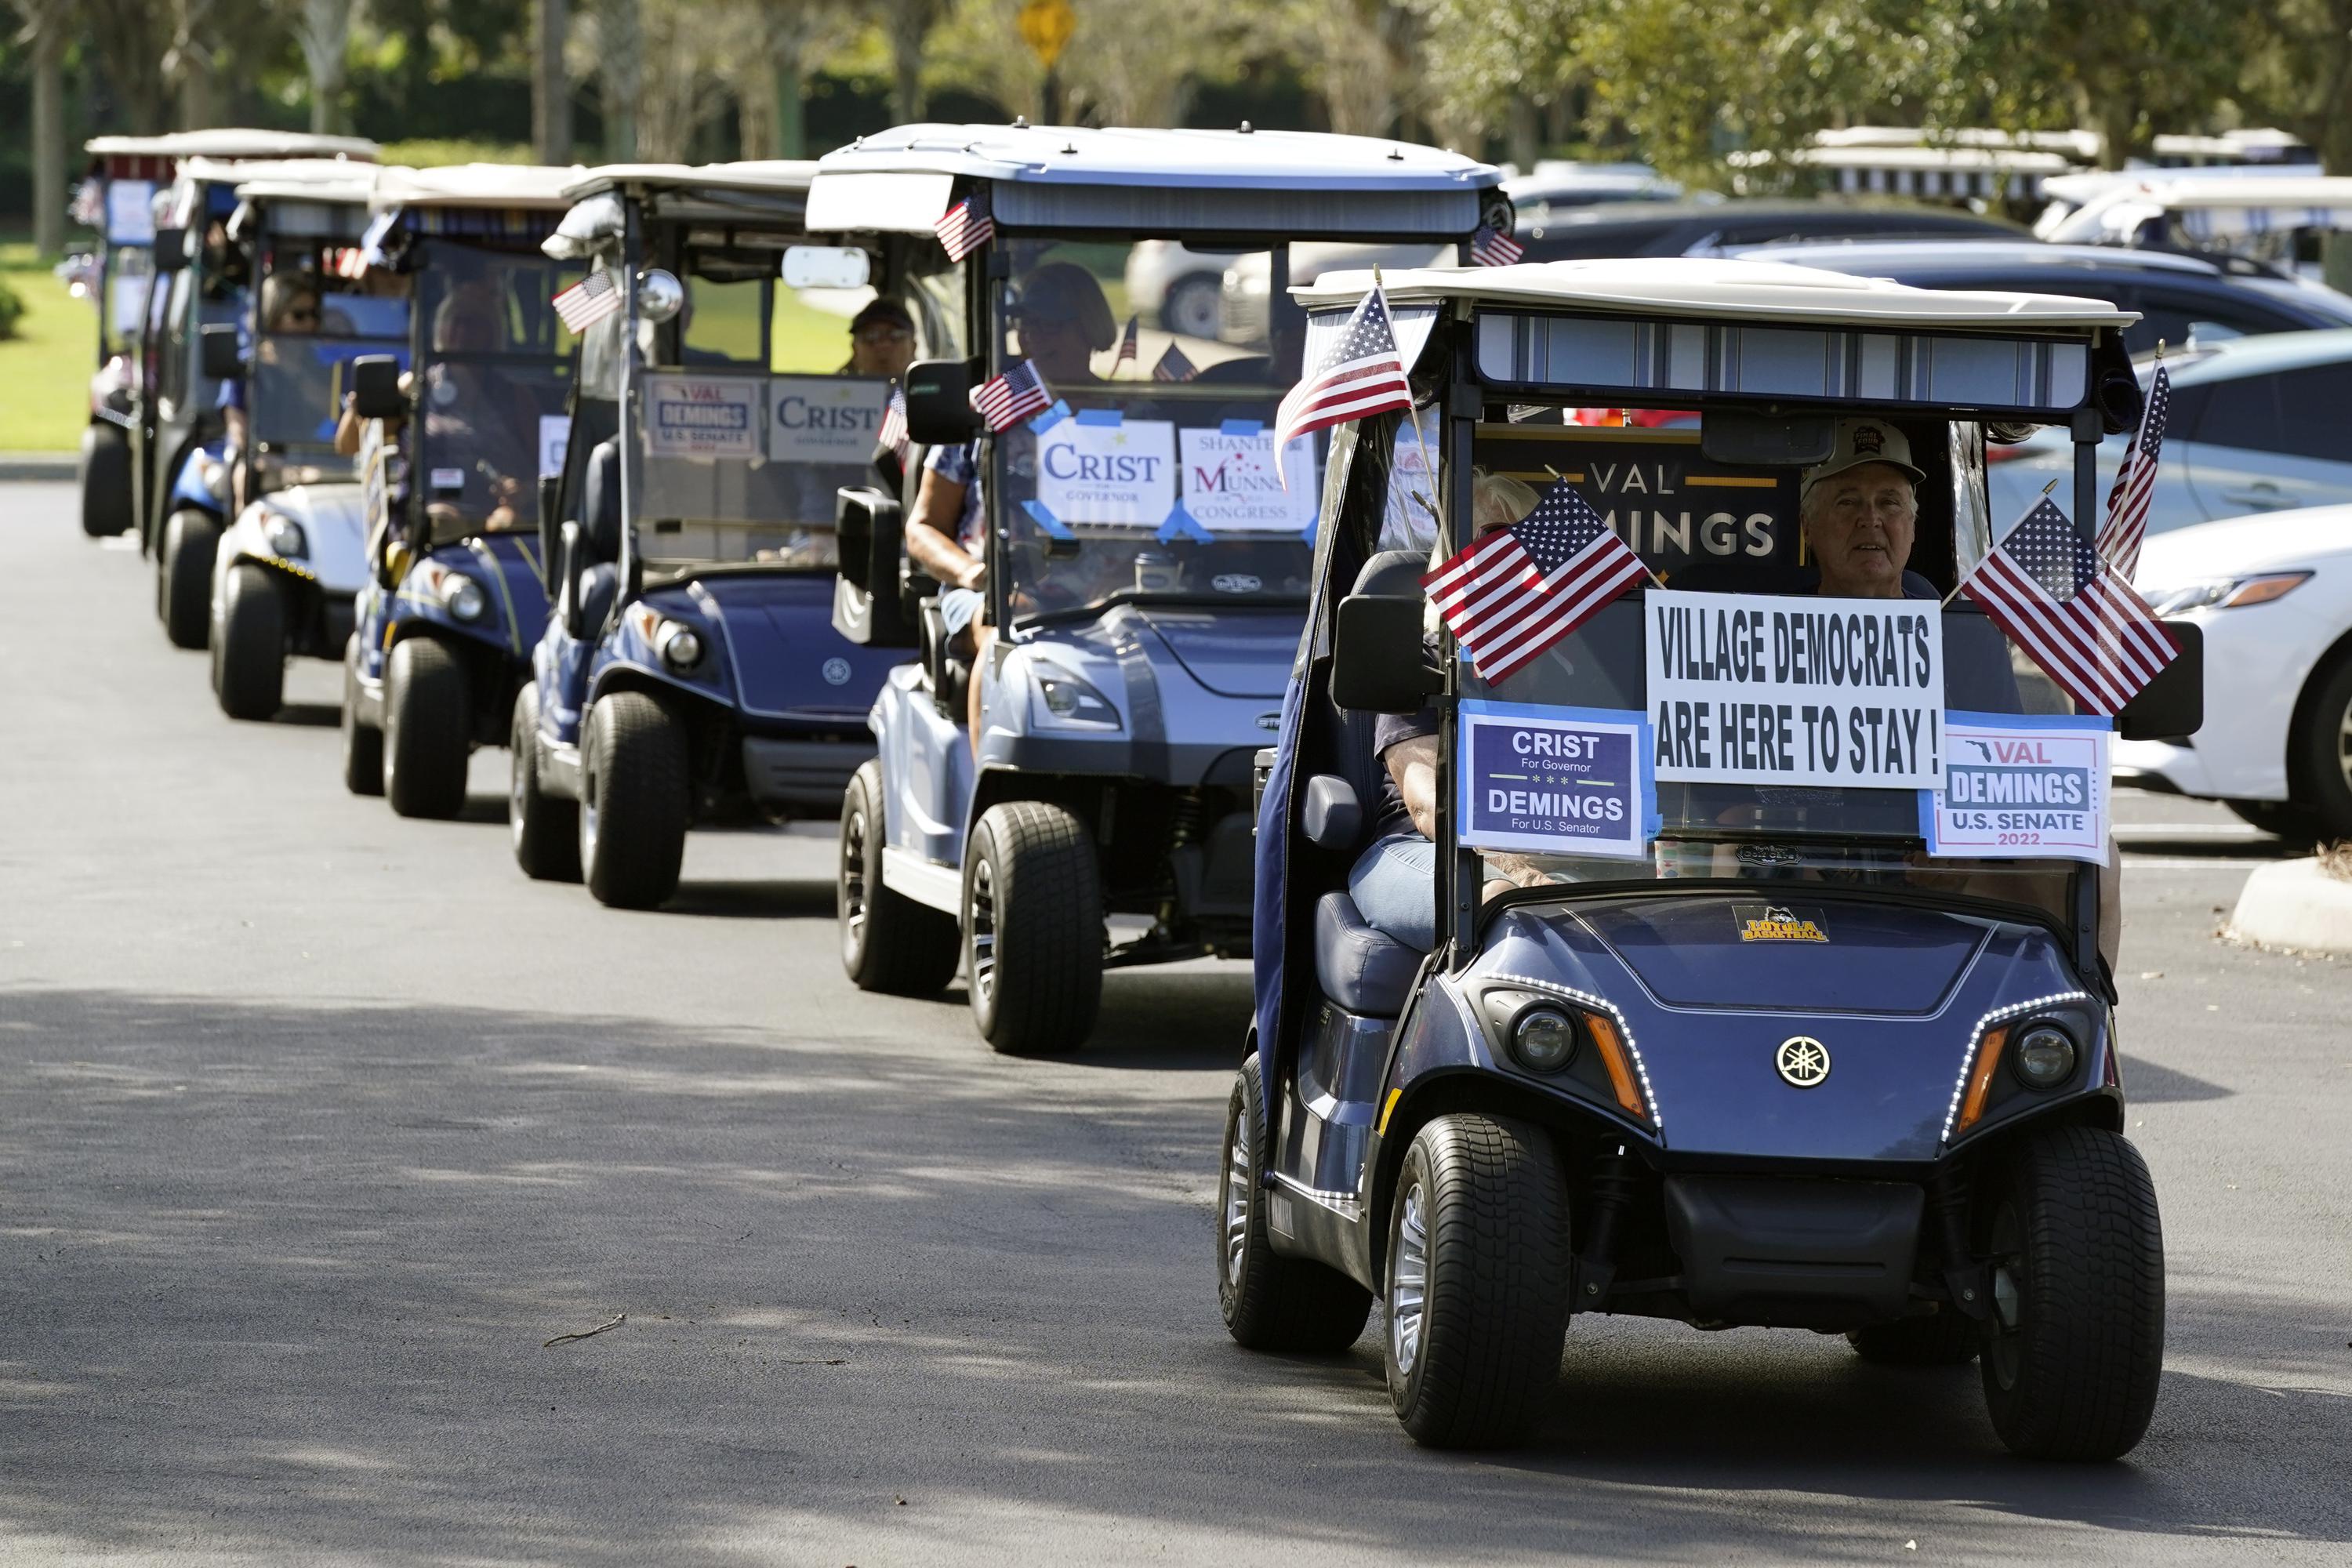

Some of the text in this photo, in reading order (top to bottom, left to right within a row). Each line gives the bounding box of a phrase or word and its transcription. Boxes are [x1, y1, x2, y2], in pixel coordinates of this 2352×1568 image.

[778, 395, 879, 430] CRIST
[1044, 443, 1160, 482] CRIST
[1590, 463, 1675, 495] VAL
[1192, 506, 1287, 519] CONGRESS
[1657, 606, 1931, 689] VILLAGE DEMOCRATS
[1512, 731, 1600, 759] CRIST
[1656, 700, 1711, 769] ARE
[1720, 702, 1795, 771] HERE
[1802, 705, 1840, 774] TO
[1994, 741, 2053, 764] VAL
[1521, 758, 1592, 773] For Governor
[1951, 771, 2082, 804] DEMINGS
[1488, 789, 1624, 822] DEMINGS
[1512, 818, 1601, 835] For U.S. Senator
[1952, 812, 2084, 831] U.S. SENATE
[1998, 833, 2041, 845] 2022
[1742, 930, 1829, 941] BASKETBALL
[1748, 920, 1818, 932] LOYOLA
